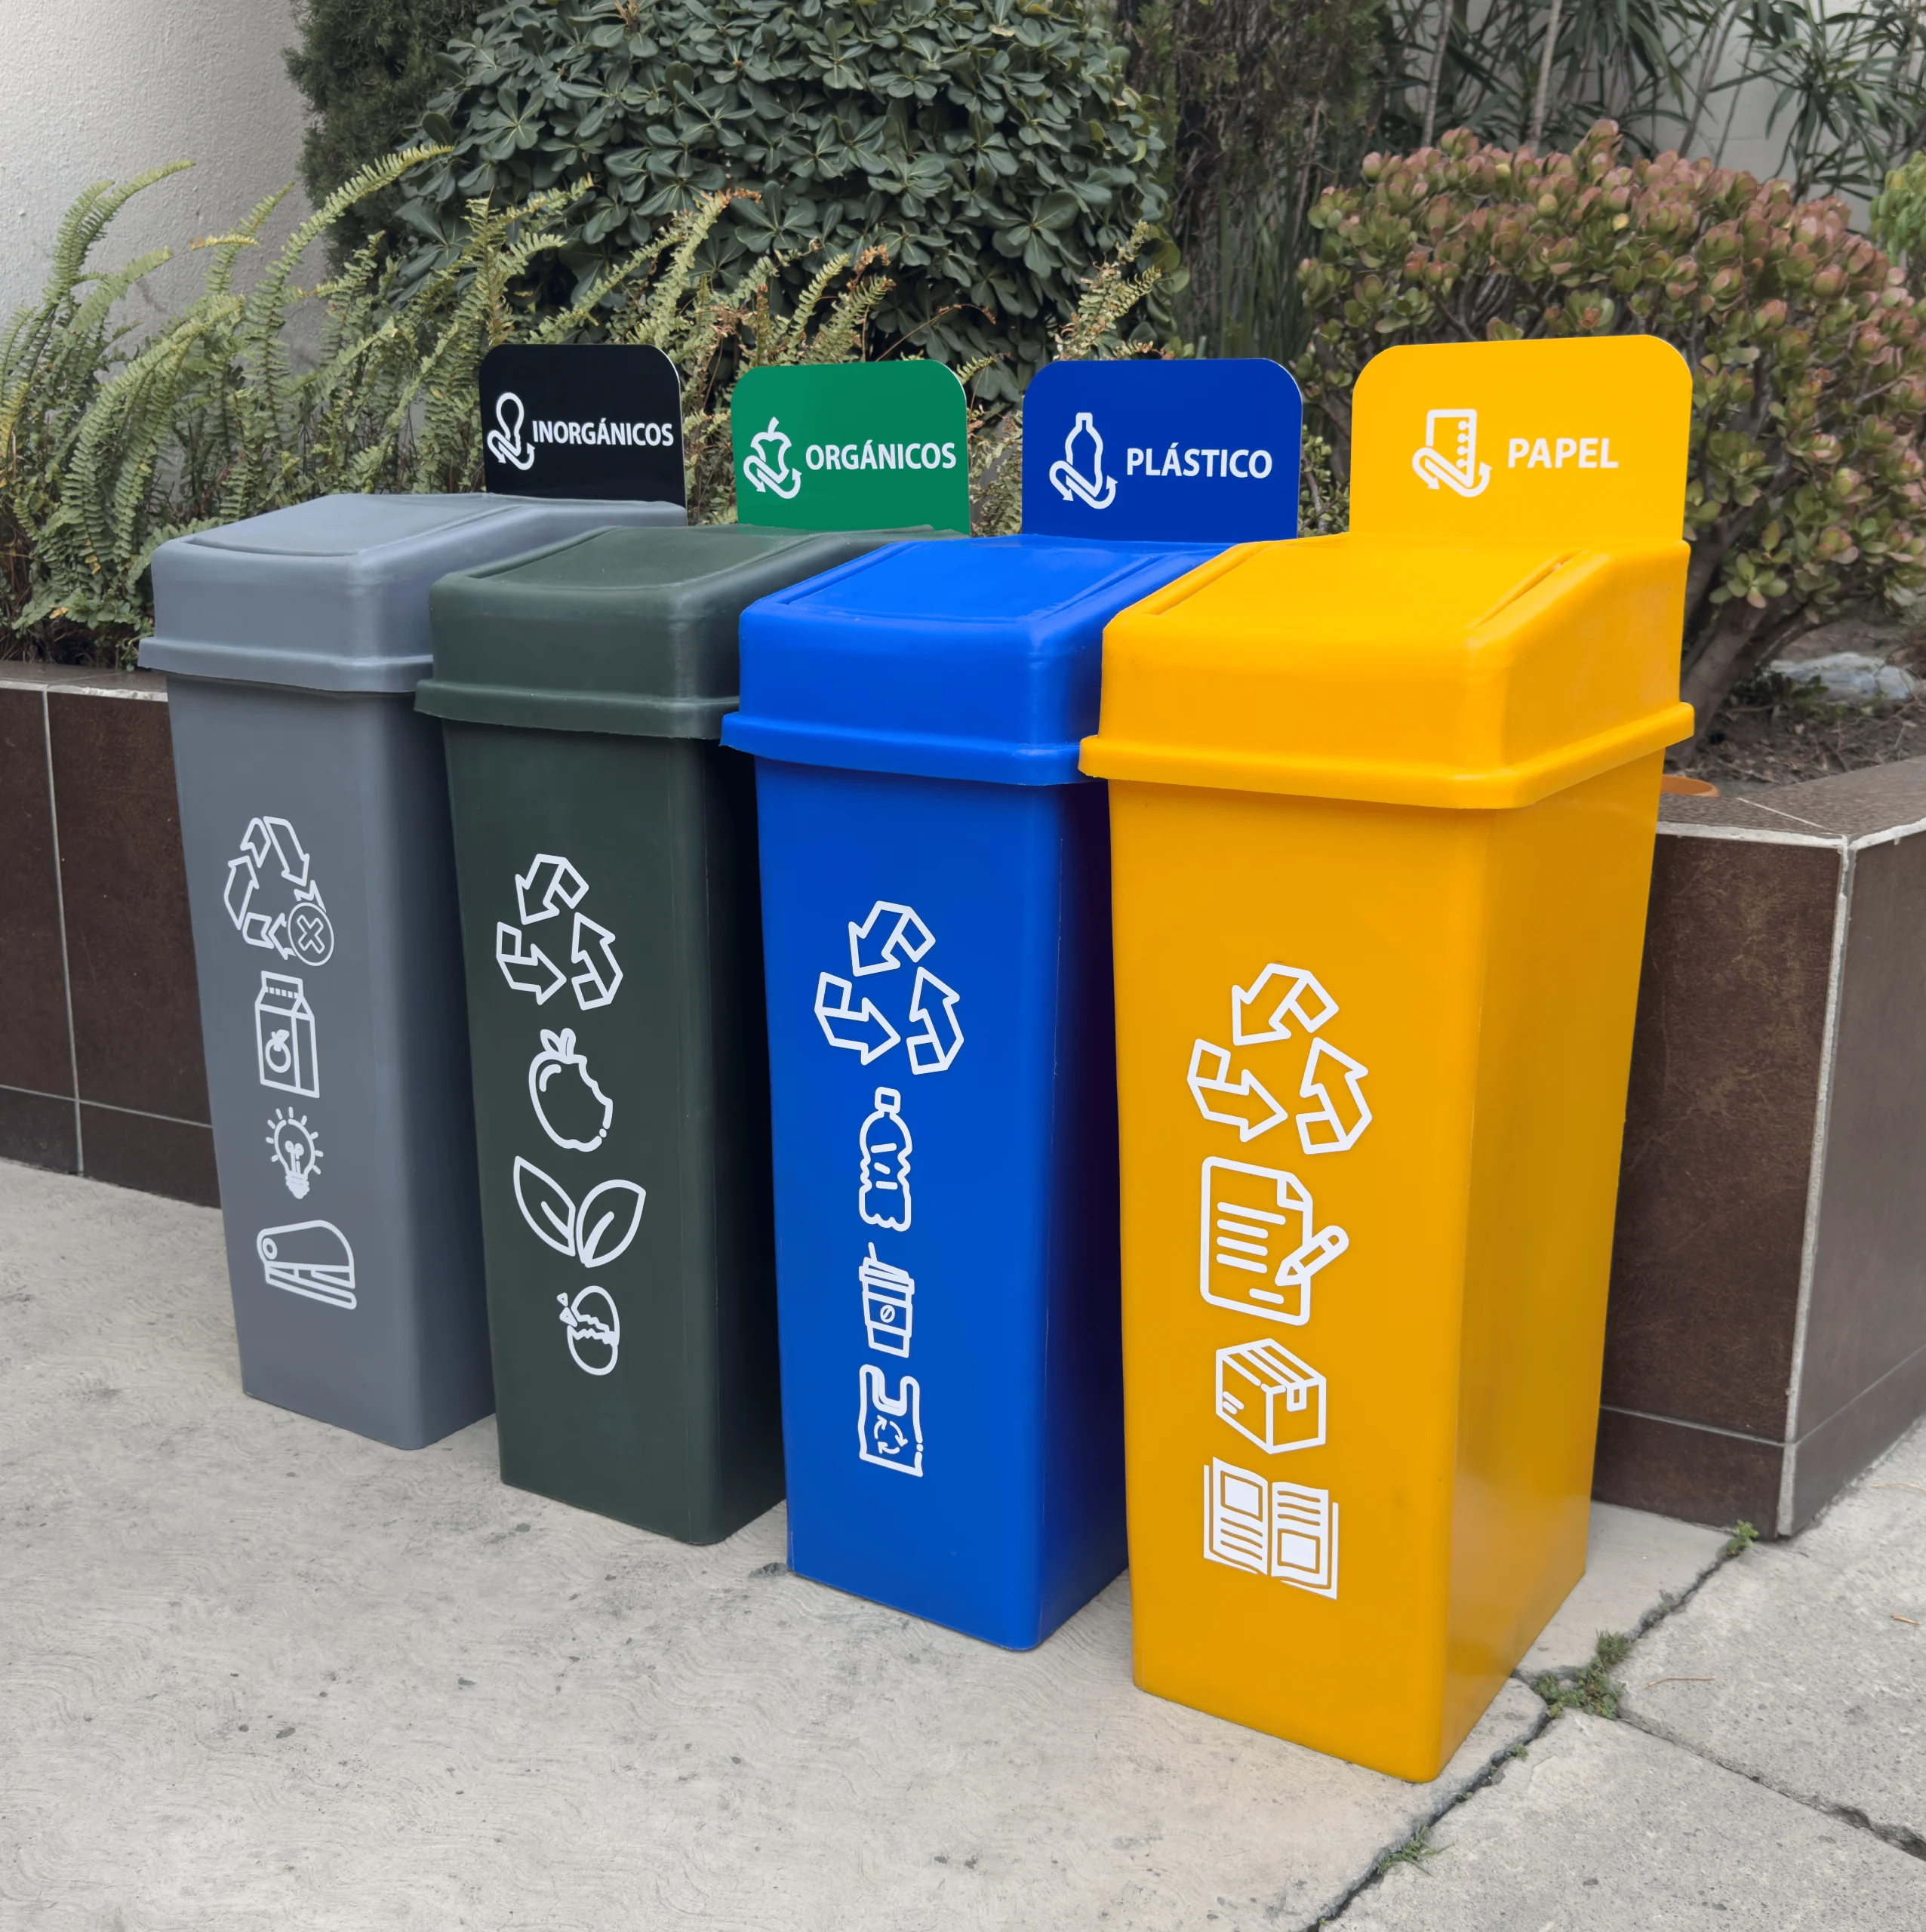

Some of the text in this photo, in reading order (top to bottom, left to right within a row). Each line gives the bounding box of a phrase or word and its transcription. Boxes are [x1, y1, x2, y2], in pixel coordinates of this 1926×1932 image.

[532, 417, 674, 447] INORGÁNICOS
[805, 440, 957, 470] ORGÁNICOS
[1127, 442, 1273, 479] PLÁSTICO
[1507, 437, 1620, 469] PAPEL
